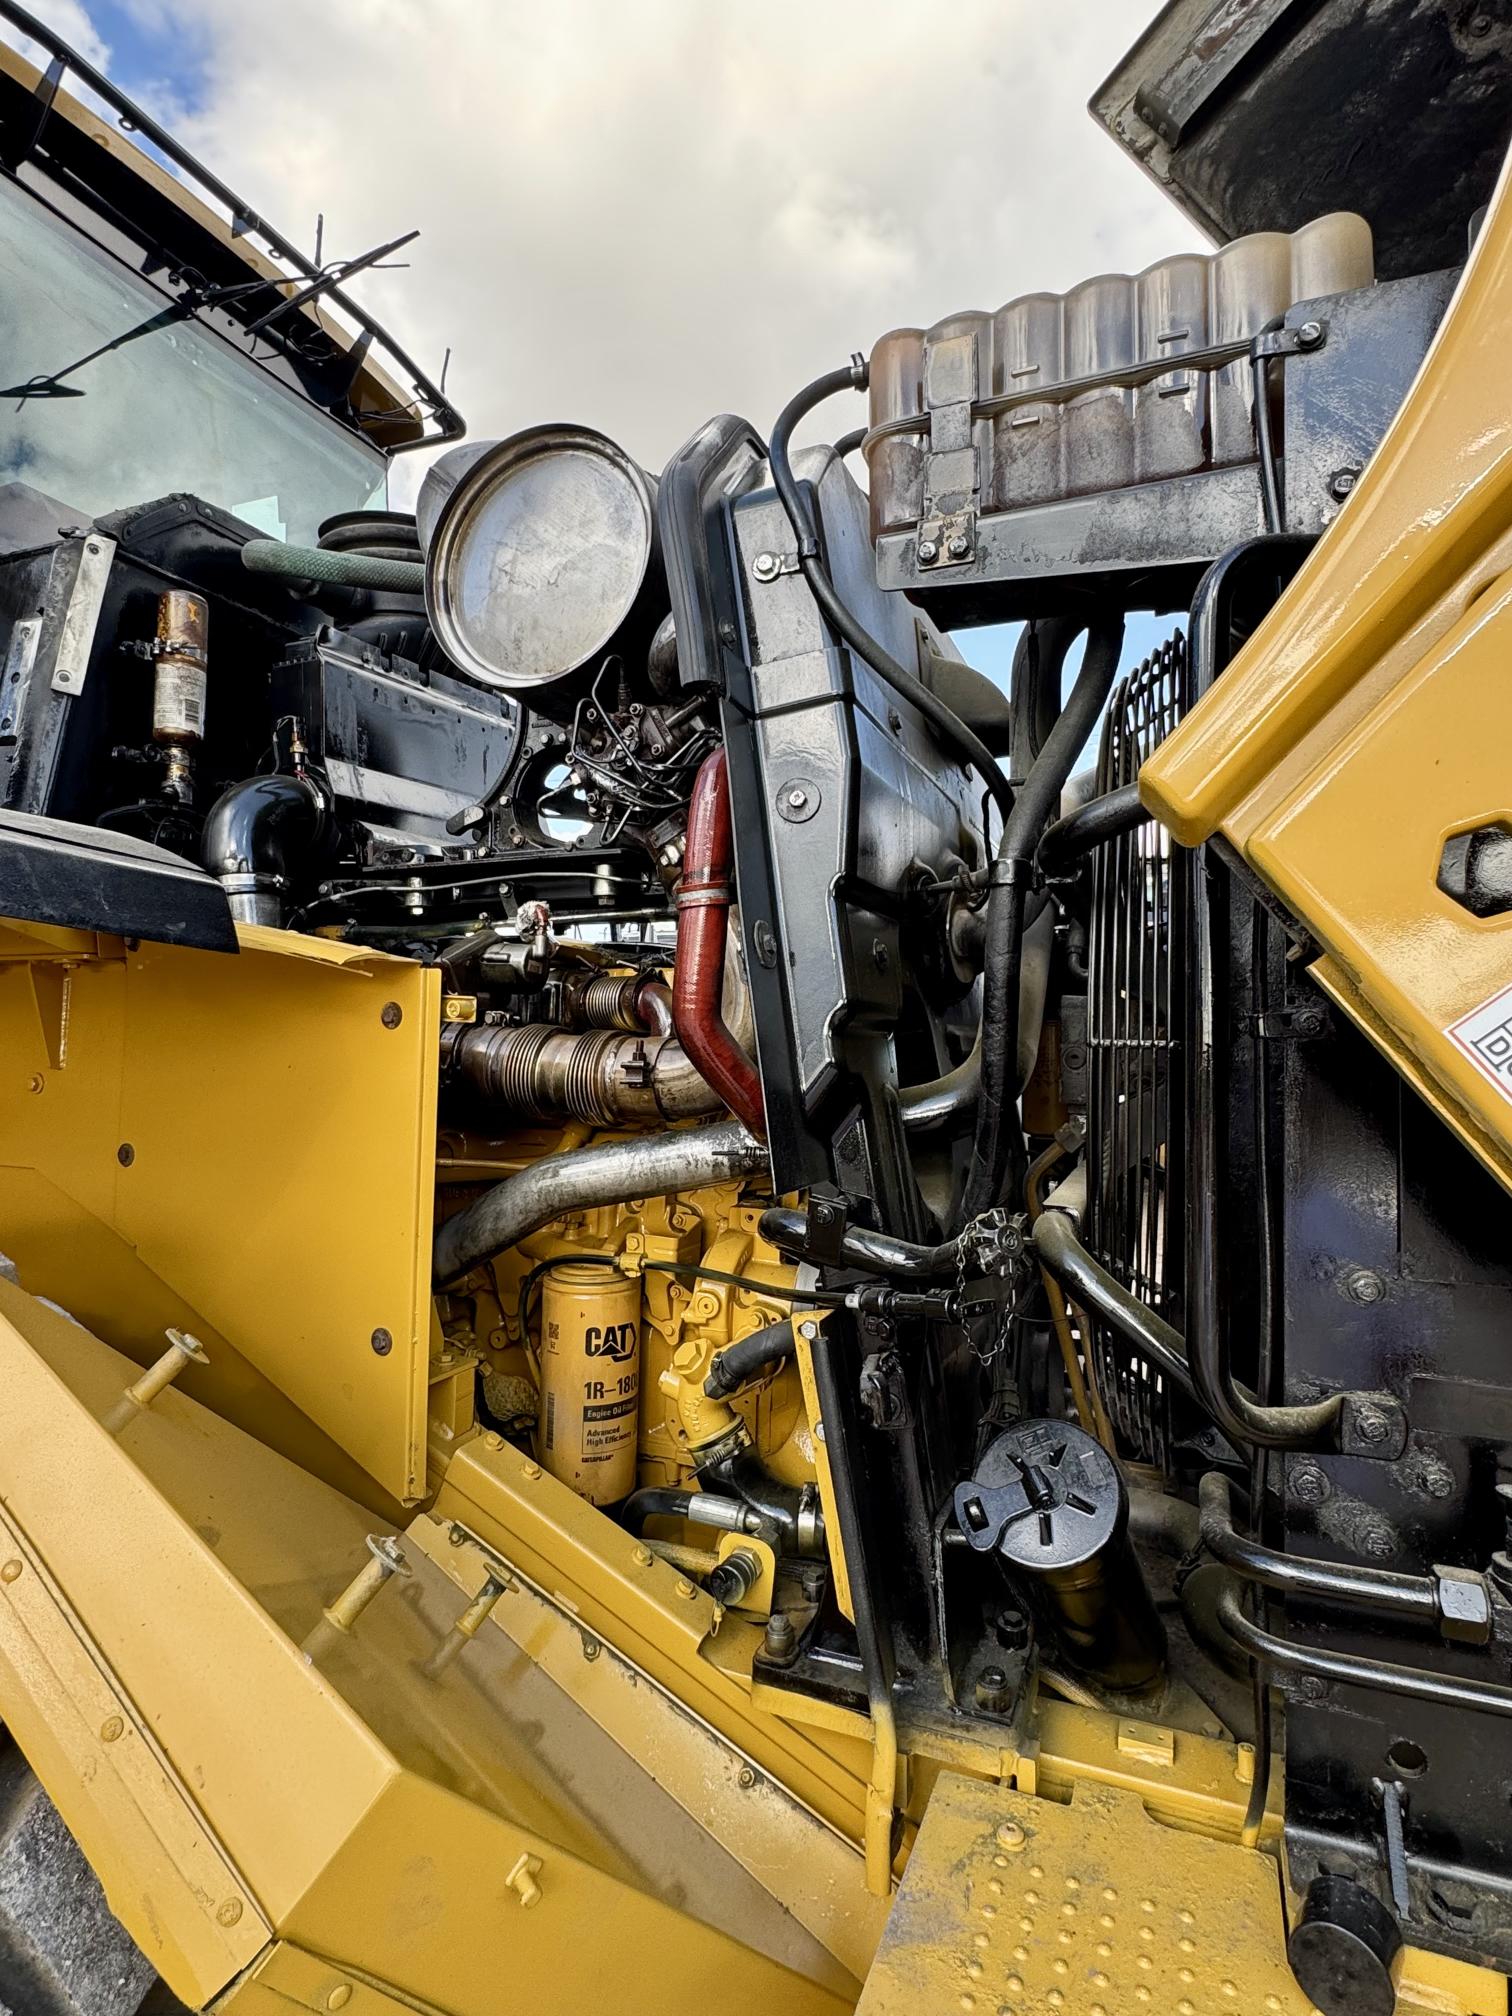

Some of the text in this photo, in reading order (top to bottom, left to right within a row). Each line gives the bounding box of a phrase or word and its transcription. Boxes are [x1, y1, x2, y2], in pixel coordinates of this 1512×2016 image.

[585, 1321, 636, 1362] CAT
[587, 1408, 611, 1419] Engine
[612, 1405, 622, 1415] Oil
[587, 1425, 620, 1437] Advanced
[587, 1431, 631, 1447] High Efficiency
